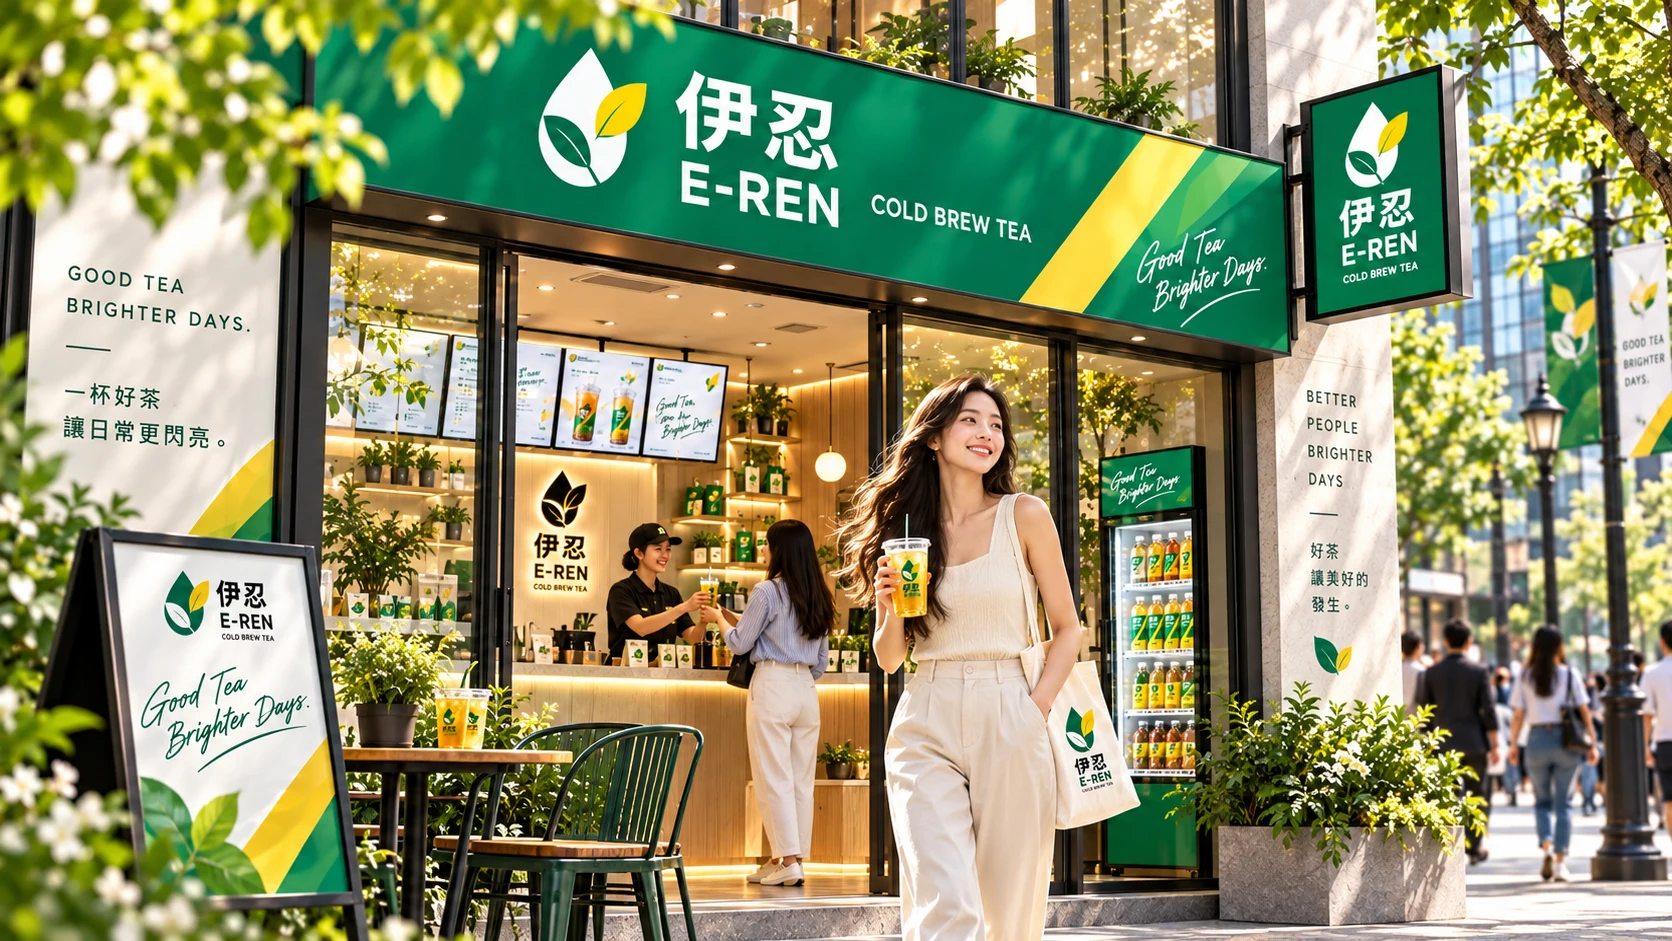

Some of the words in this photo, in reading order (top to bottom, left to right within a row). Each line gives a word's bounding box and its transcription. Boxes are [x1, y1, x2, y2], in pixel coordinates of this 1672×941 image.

[675, 70, 839, 171] 伊忍
[681, 159, 840, 229] E-REN
[871, 194, 928, 223] COLD
[934, 206, 990, 236] BREW
[998, 218, 1032, 244] TEA
[1339, 187, 1415, 239] 伊忍
[1136, 232, 1189, 284] Good
[1193, 227, 1226, 265] Tea
[1341, 229, 1418, 267] E-REN
[68, 265, 132, 287] GOOD
[143, 274, 184, 294] TEA
[1342, 271, 1369, 284] COLD
[1370, 265, 1397, 279] BREW
[1399, 261, 1419, 273] TEA
[1152, 266, 1220, 313] Brighter
[1222, 256, 1267, 287] Days.
[67, 298, 176, 325] BRIGHTER
[189, 311, 250, 332] DAYS.
[1622, 338, 1647, 351] GOOD
[1649, 334, 1665, 346] TEA
[1623, 352, 1665, 370] BRIGHTER
[1624, 374, 1650, 388] DAYS.
[64, 382, 161, 410] 一杯好茶
[1306, 389, 1357, 409] BETTER
[63, 415, 226, 449] 讓日常更閃亮。
[1307, 416, 1358, 435] PEOPLE
[1307, 444, 1373, 464] BRIGHTER
[1308, 472, 1343, 488] DAYS
[534, 532, 586, 560] 伊忍
[1310, 542, 1339, 560] 好茶
[534, 562, 588, 581] E-REN
[1310, 570, 1369, 588] 讓美好的
[215, 579, 267, 609] 伊忍
[533, 583, 552, 591] COLD
[553, 584, 574, 592] BREW
[1311, 596, 1351, 613] 發生。
[219, 612, 274, 631] E-REN
[221, 633, 240, 641] COLD
[241, 633, 261, 642] BREW
[261, 634, 275, 642] TEA
[140, 672, 206, 729] Good
[209, 666, 248, 705] Tea
[165, 706, 250, 760] Brighter
[254, 694, 310, 728] Days.
[1074, 753, 1107, 775] 伊忍
[1079, 770, 1112, 787] E-REN
